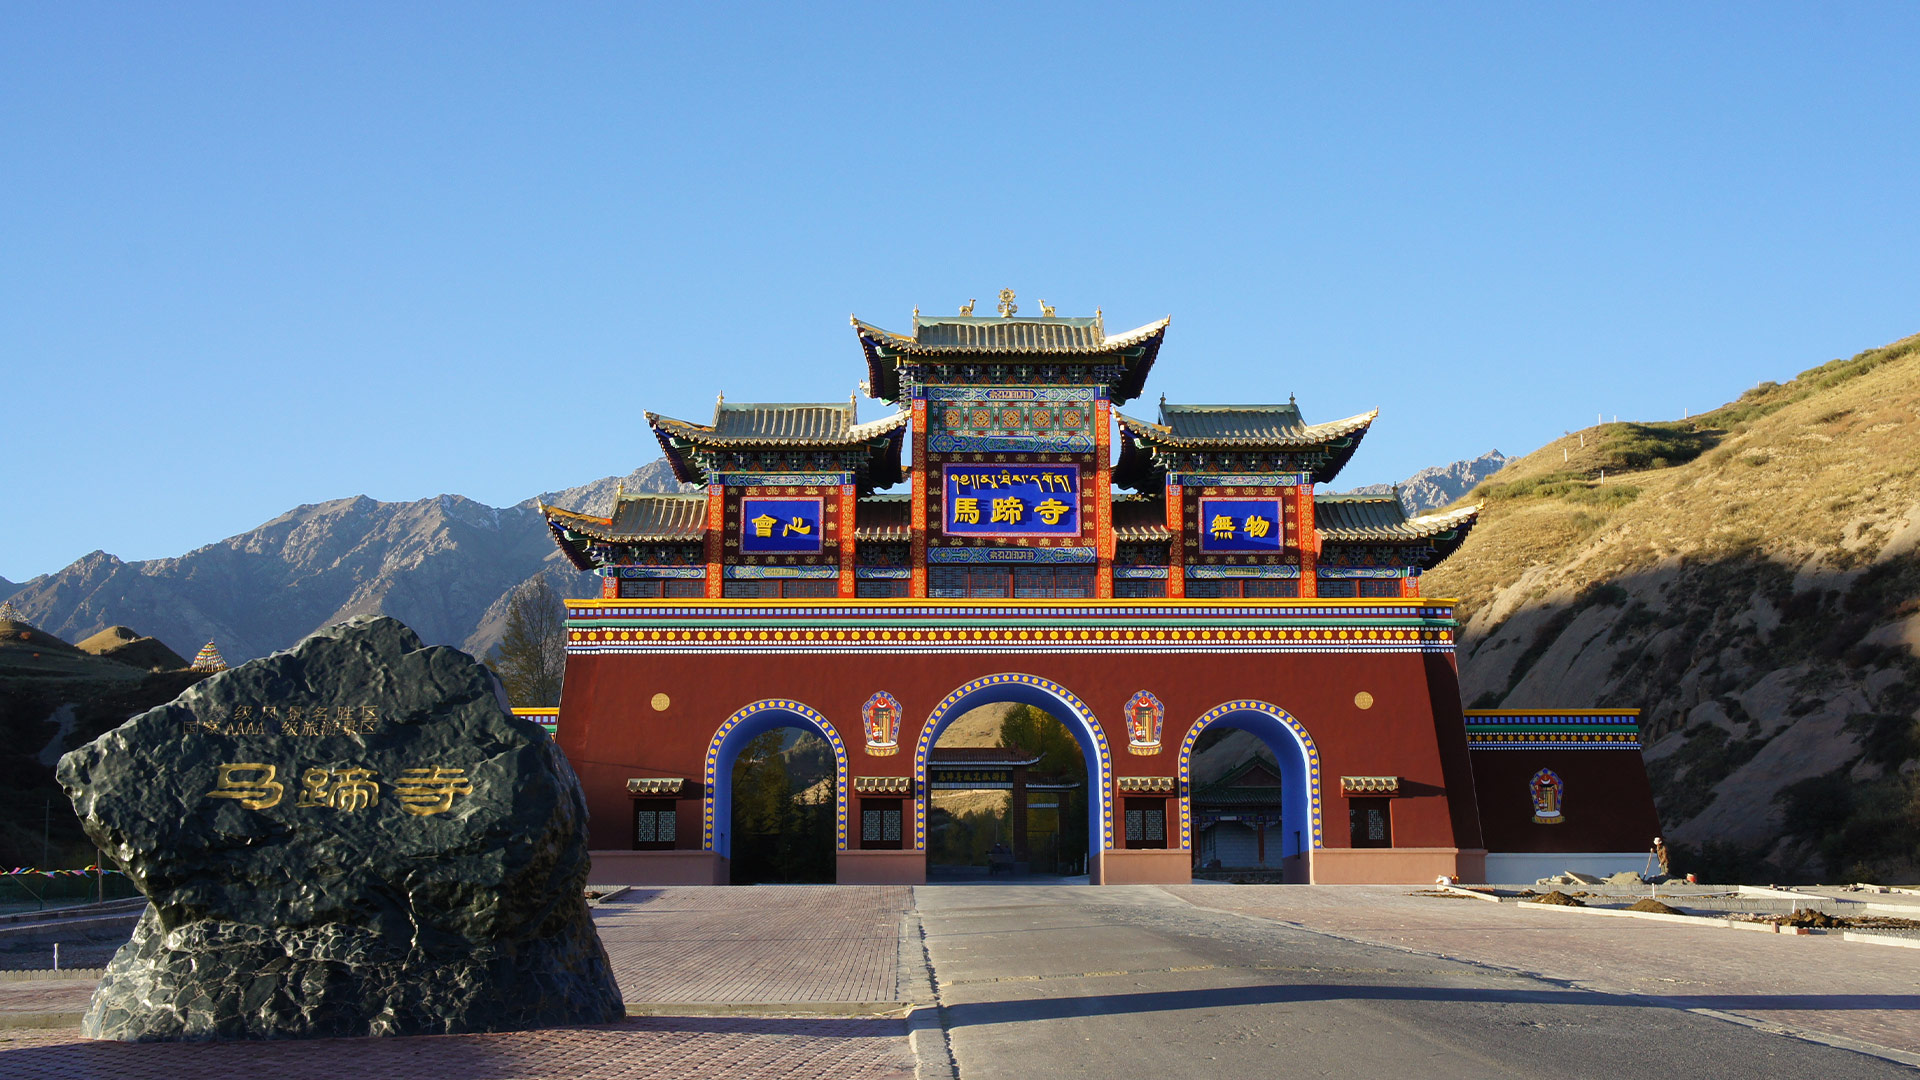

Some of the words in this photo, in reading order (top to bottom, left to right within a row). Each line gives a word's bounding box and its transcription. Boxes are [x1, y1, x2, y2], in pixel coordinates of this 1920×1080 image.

[954, 496, 1069, 525] 馬蹄寺
[752, 514, 810, 537] 會心
[1210, 514, 1270, 540] 無物
[206, 763, 473, 816] 马蹄寺
